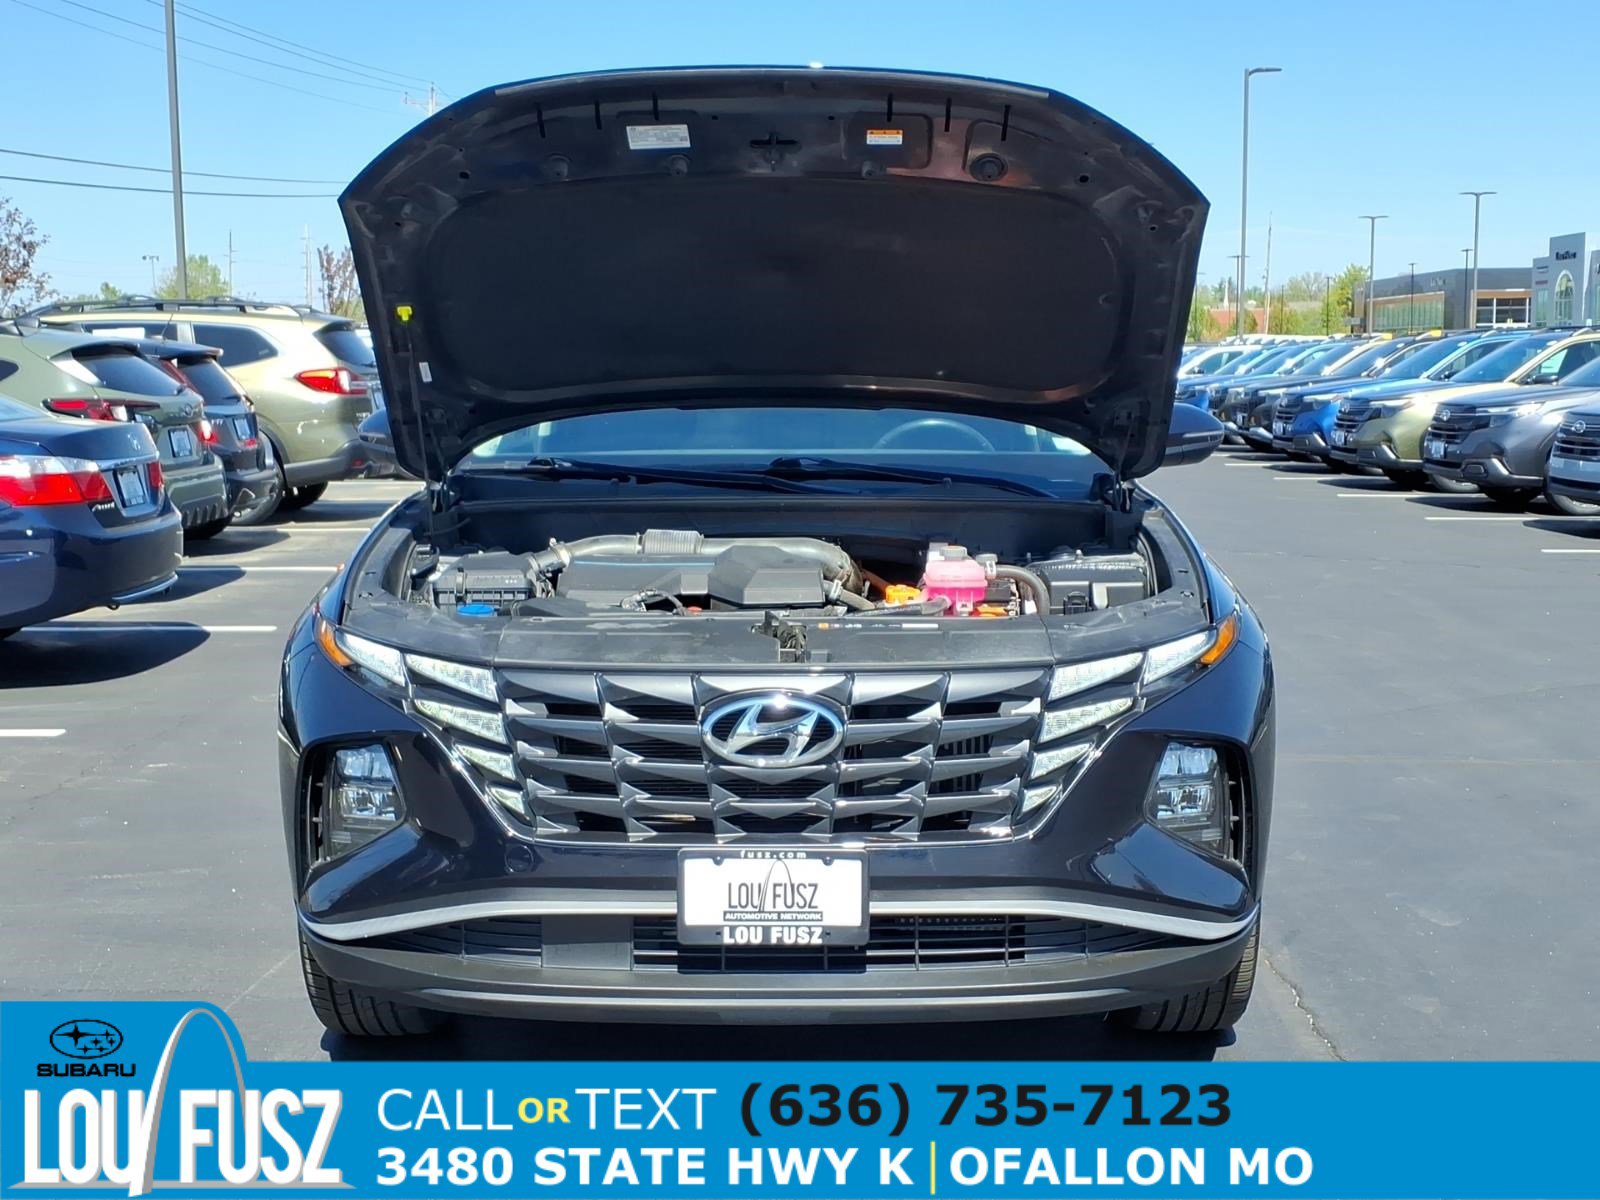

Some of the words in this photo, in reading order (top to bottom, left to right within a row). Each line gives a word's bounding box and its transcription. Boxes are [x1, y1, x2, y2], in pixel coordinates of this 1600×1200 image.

[740, 850, 807, 859] fusz.com
[728, 882, 762, 909] LOU
[772, 882, 818, 909] FUSZ
[724, 912, 779, 920] AUTOMOTIVE
[780, 912, 822, 920] NETWORK
[723, 926, 763, 944] LOU
[770, 926, 823, 944] FUSZ
